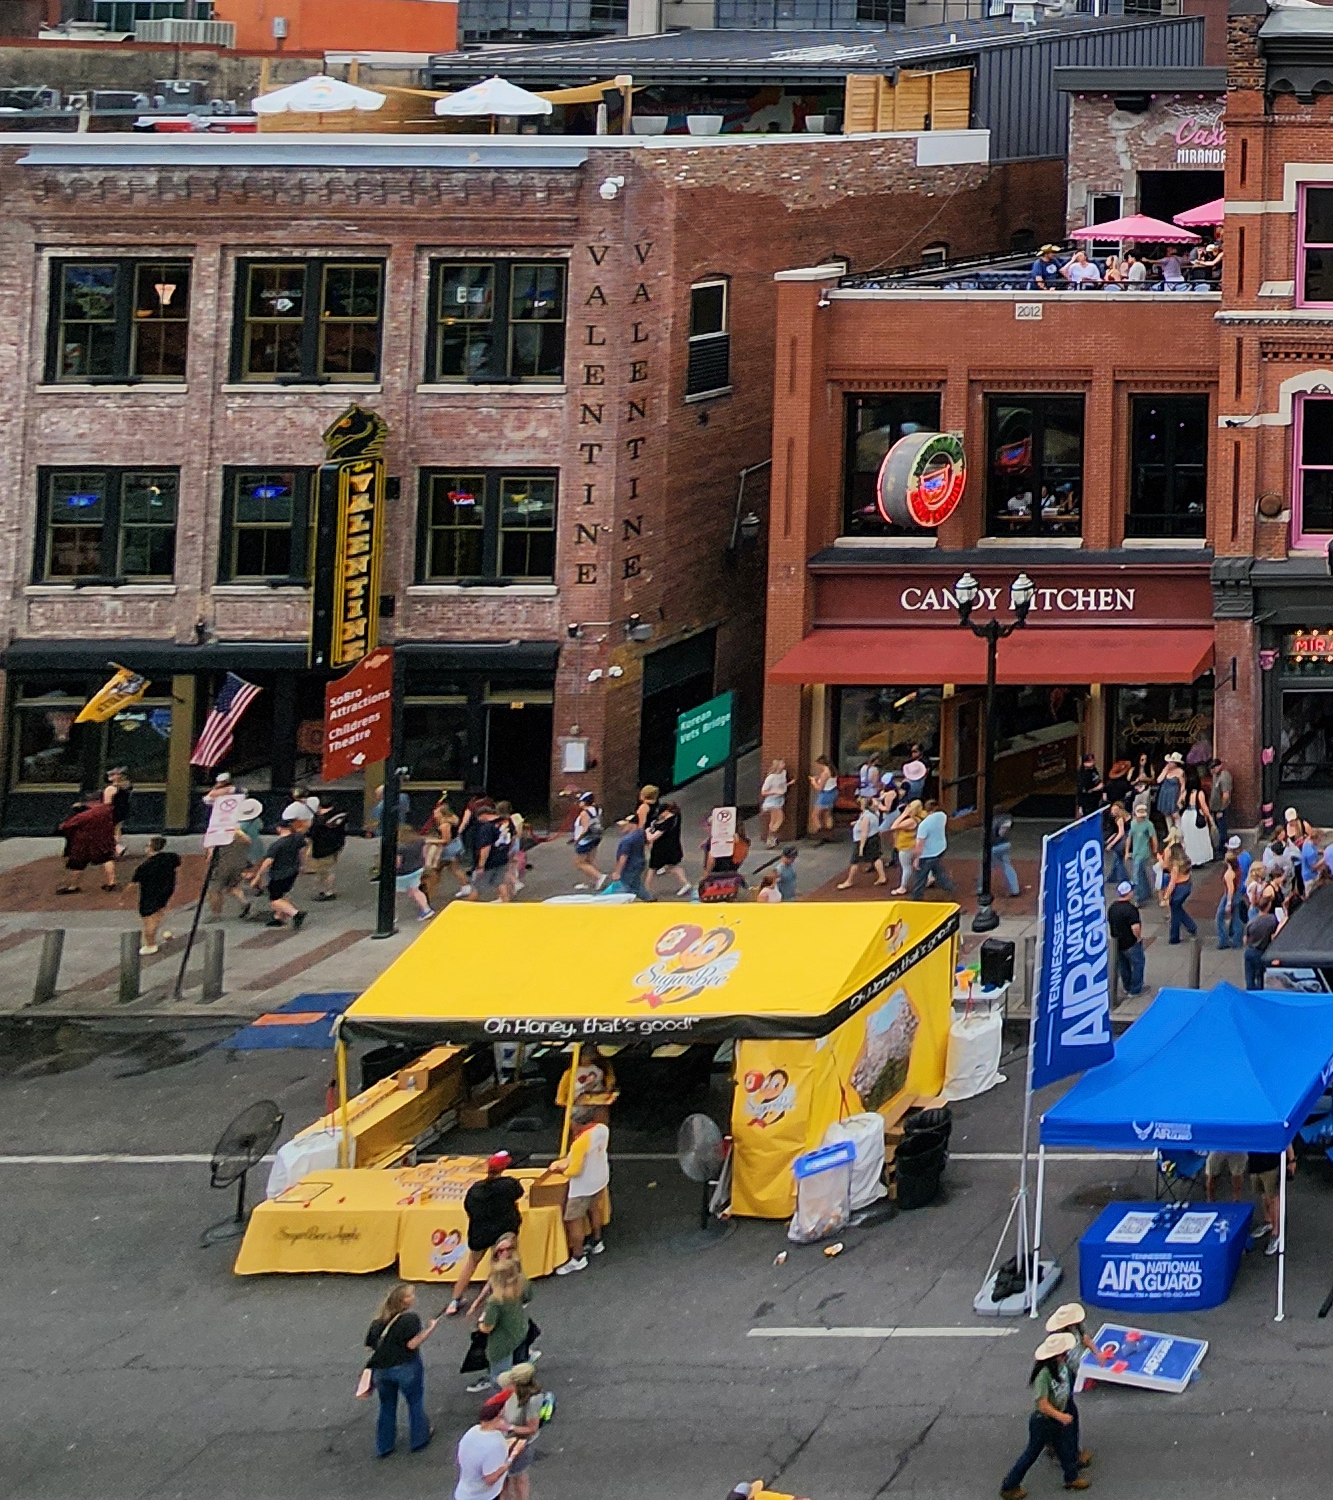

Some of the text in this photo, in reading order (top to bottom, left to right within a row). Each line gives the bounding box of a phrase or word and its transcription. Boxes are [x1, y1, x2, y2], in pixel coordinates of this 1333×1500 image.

[1017, 305, 1041, 318] 2012
[575, 245, 610, 585] VALENTINE
[621, 243, 654, 580] VALENTINE
[1008, 588, 1135, 612] ITCHEN
[329, 687, 362, 709] SoBro
[329, 688, 390, 722] Attractions
[328, 710, 380, 741] Childrens
[328, 728, 371, 754] Theatre
[680, 711, 732, 745] Vets Bridge
[1066, 851, 1085, 963] NATIONAL
[1080, 838, 1107, 957] GUARD
[1047, 909, 1064, 1016] TENNESSEE
[1060, 952, 1110, 1046] AIR
[484, 1018, 512, 1033] Oh
[583, 1017, 636, 1033] that's
[1153, 1128, 1171, 1140] AIR
[1097, 1260, 1146, 1291] AIR
[1145, 1273, 1203, 1291] GUARD
[1146, 1260, 1203, 1274] NATIONAL
